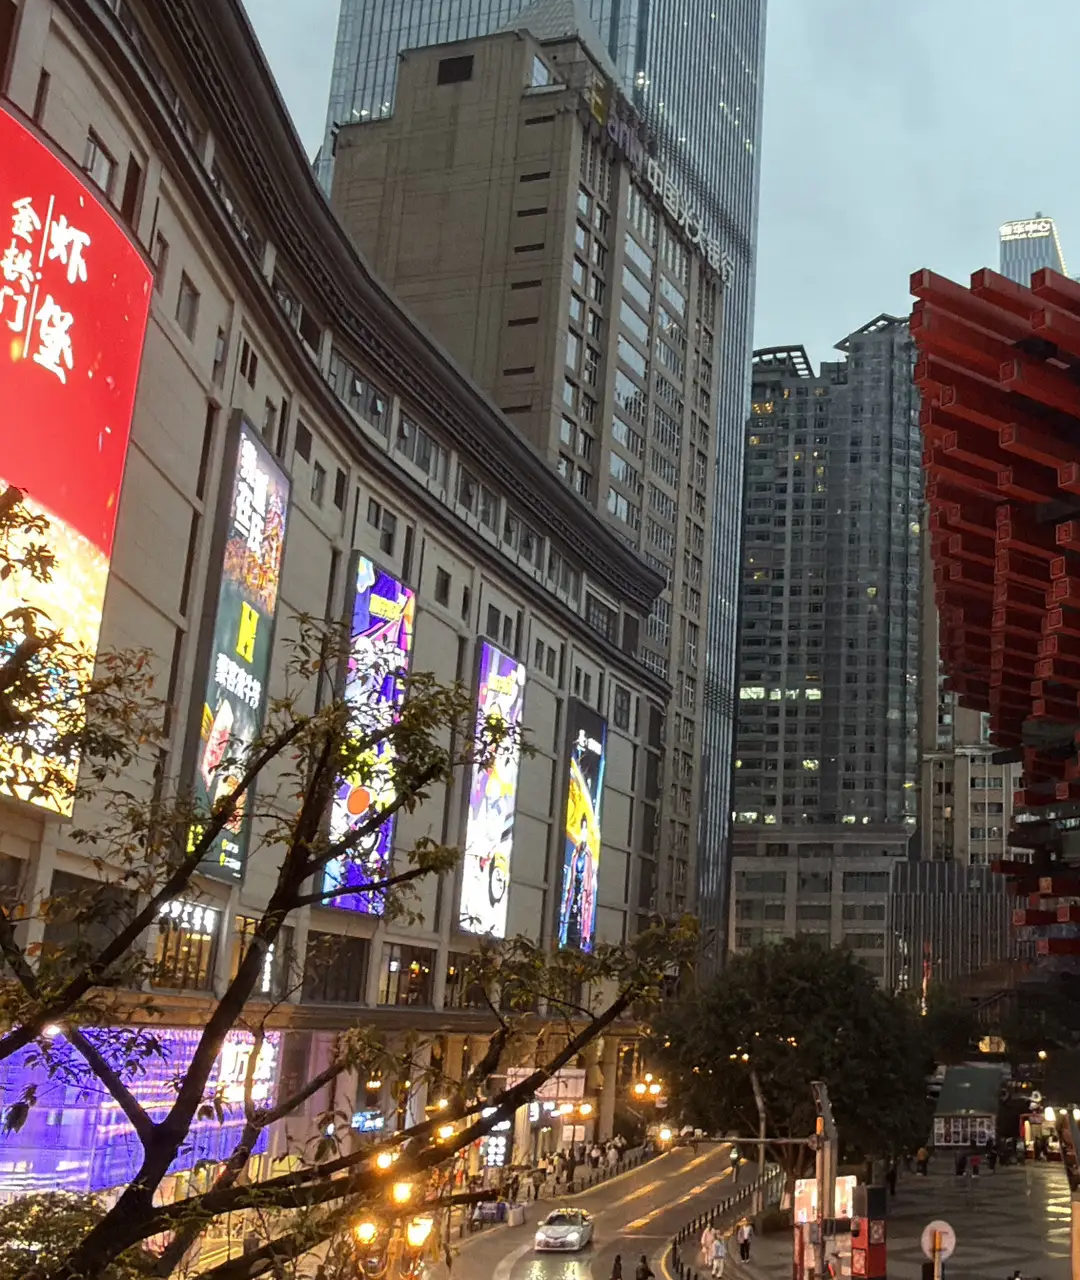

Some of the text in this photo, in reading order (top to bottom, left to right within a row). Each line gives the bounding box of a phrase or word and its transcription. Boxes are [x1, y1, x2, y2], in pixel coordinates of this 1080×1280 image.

[647, 157, 735, 289] 中国光大银行
